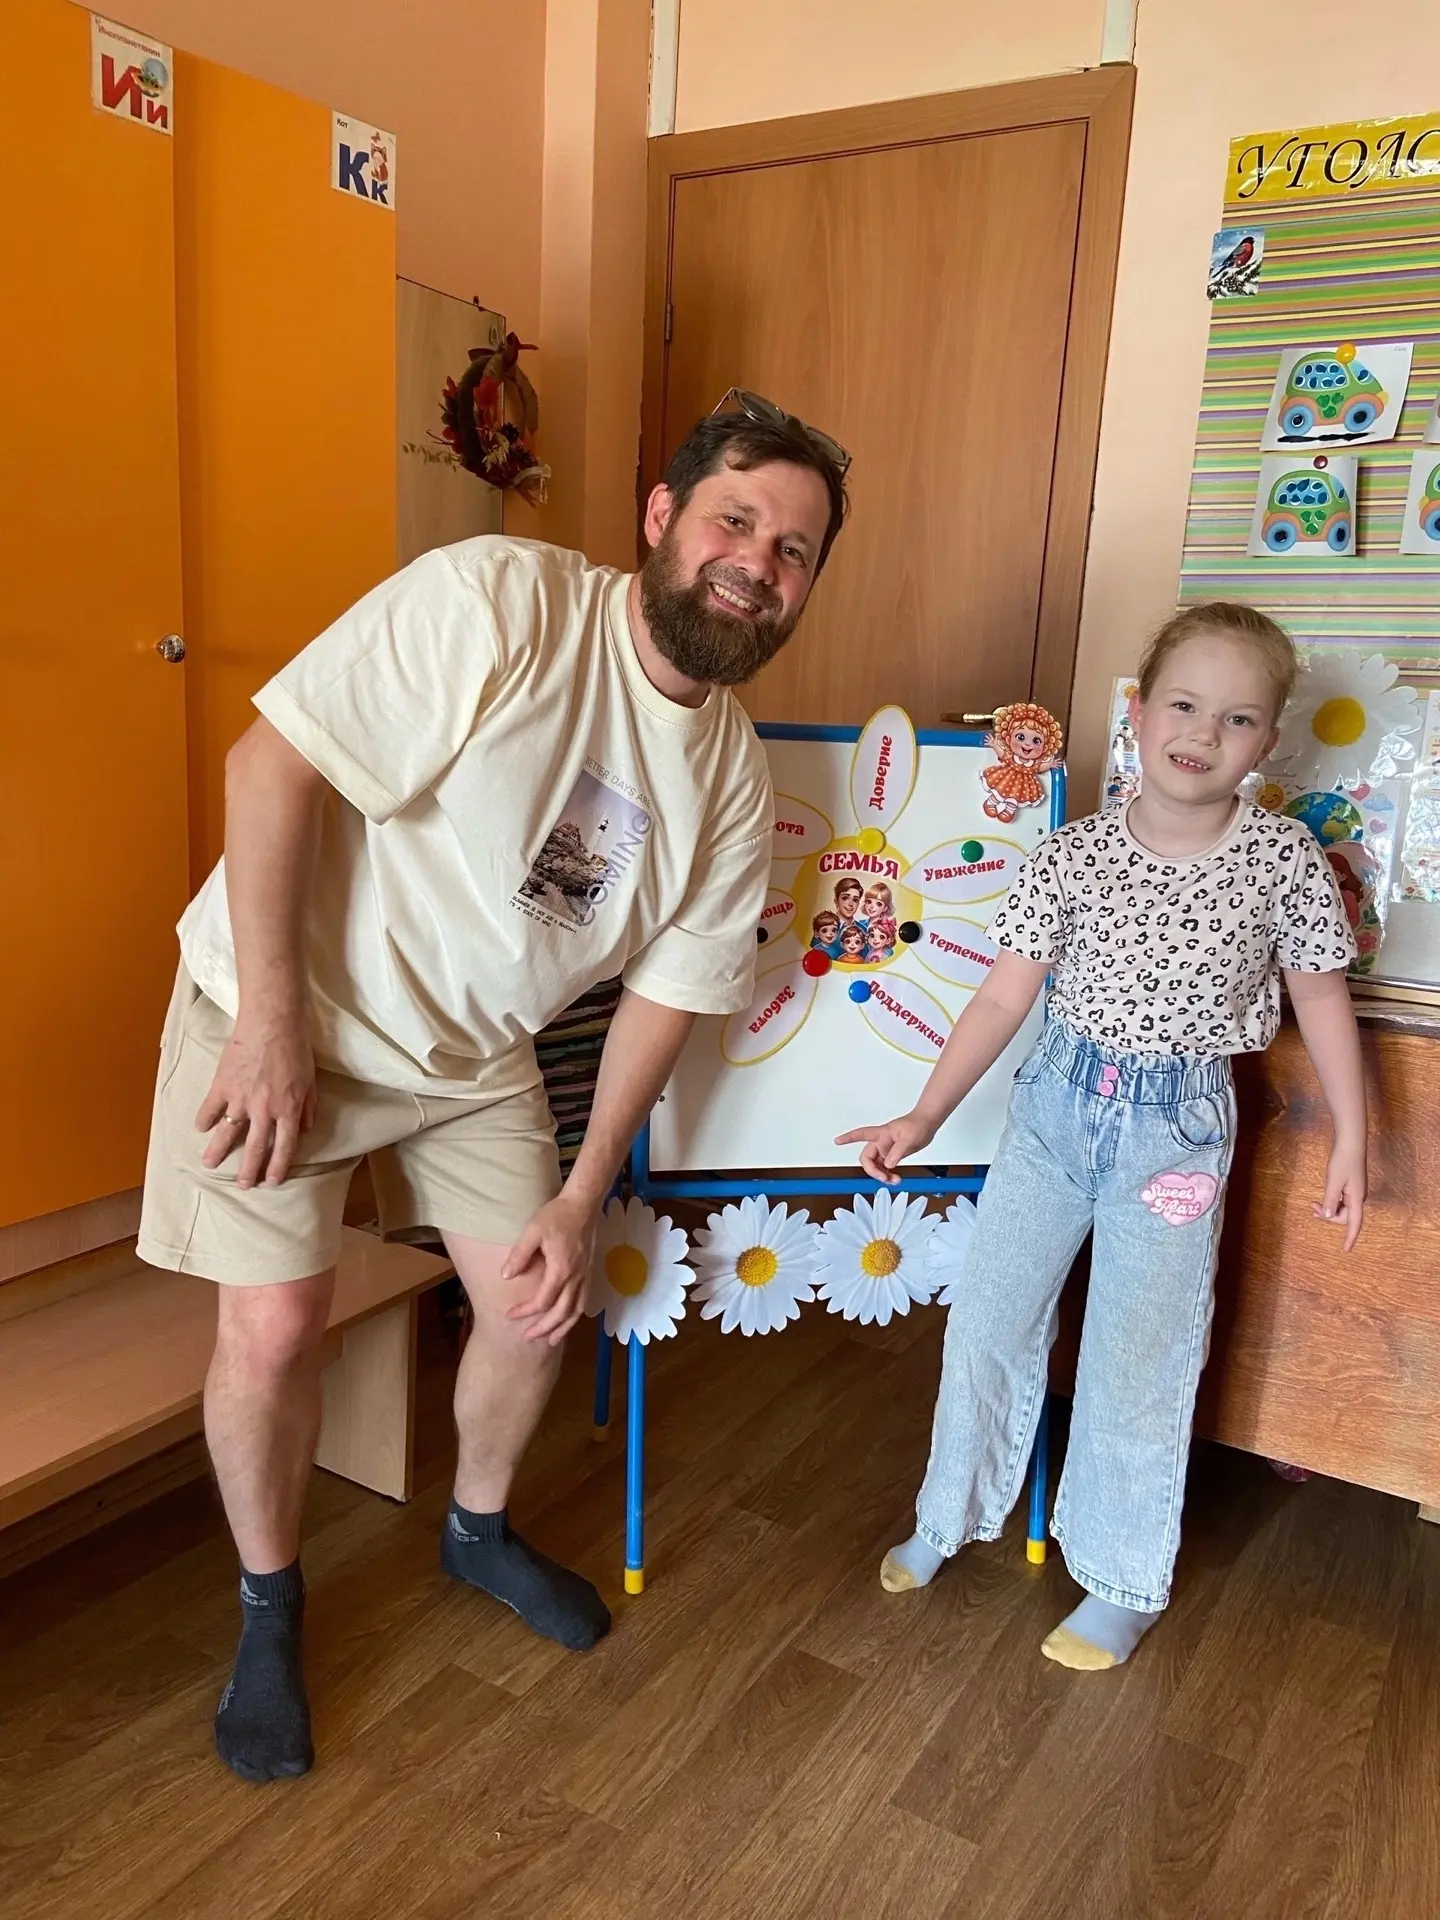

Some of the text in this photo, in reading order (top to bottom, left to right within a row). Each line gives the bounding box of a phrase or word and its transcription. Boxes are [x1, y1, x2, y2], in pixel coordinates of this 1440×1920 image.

[335, 117, 348, 129] Кот
[584, 756, 652, 809] BETTER DAYS ARE
[869, 735, 893, 811] Доверие
[773, 821, 805, 836] ота
[577, 811, 653, 927] COMING
[818, 851, 899, 881] СЕМЬЯ
[923, 858, 1006, 882] Уважение
[761, 901, 794, 920] ощь
[929, 932, 995, 968] Терпение
[748, 985, 796, 1034] Забота
[869, 980, 946, 1049] Поддержка
[1142, 1182, 1195, 1202] Sweet
